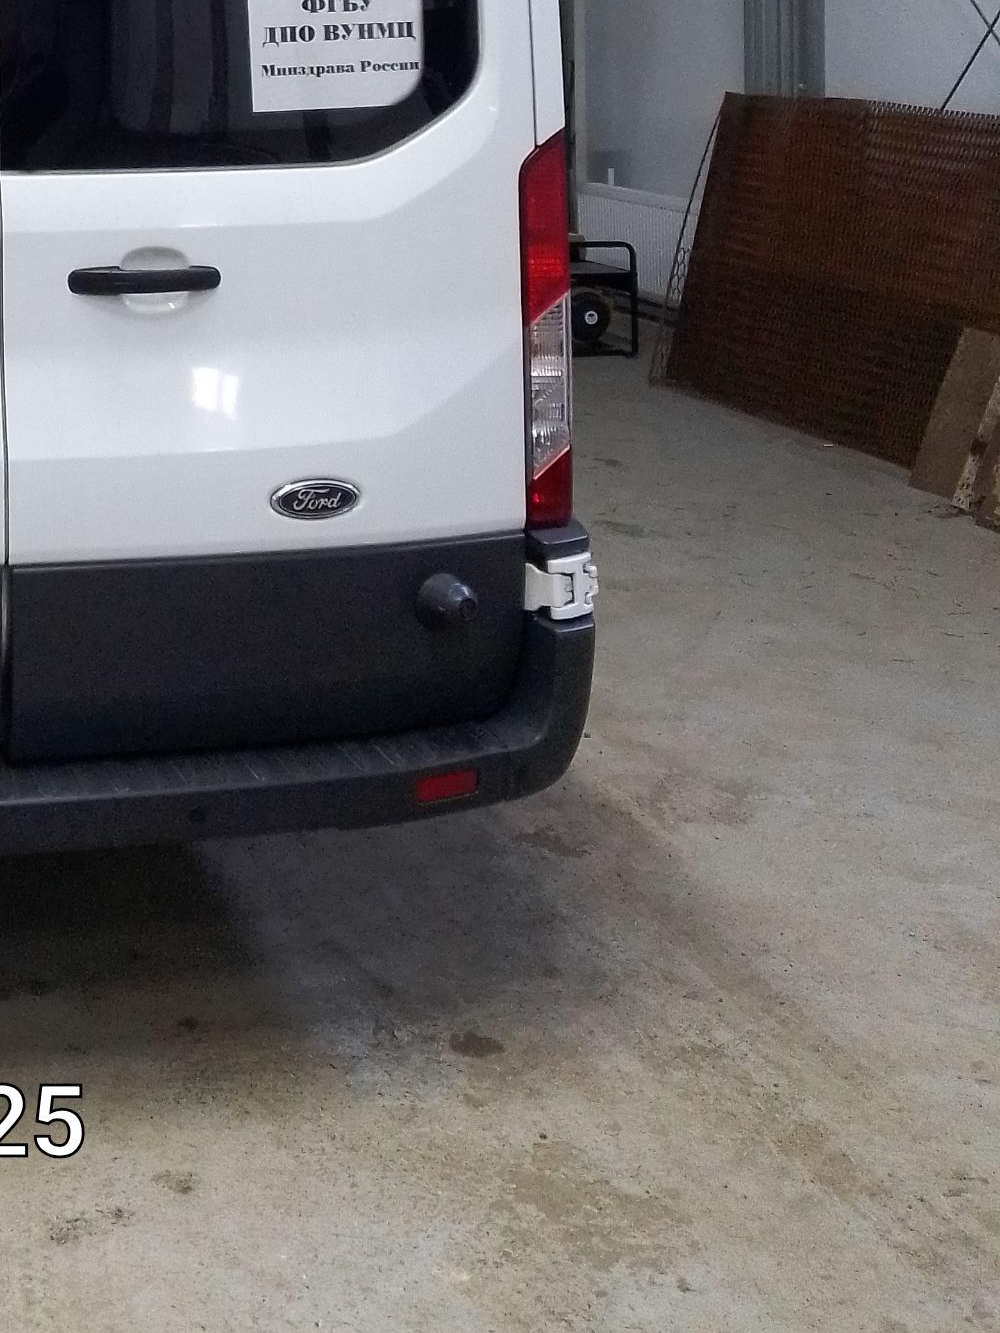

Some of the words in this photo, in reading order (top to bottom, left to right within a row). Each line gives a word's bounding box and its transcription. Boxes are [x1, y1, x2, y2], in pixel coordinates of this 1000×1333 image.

[262, 25, 315, 47] ДПО
[322, 21, 416, 41] ВУНМЦ
[261, 63, 355, 77] Минздрава
[359, 60, 420, 73] России
[293, 488, 341, 510] Ford
